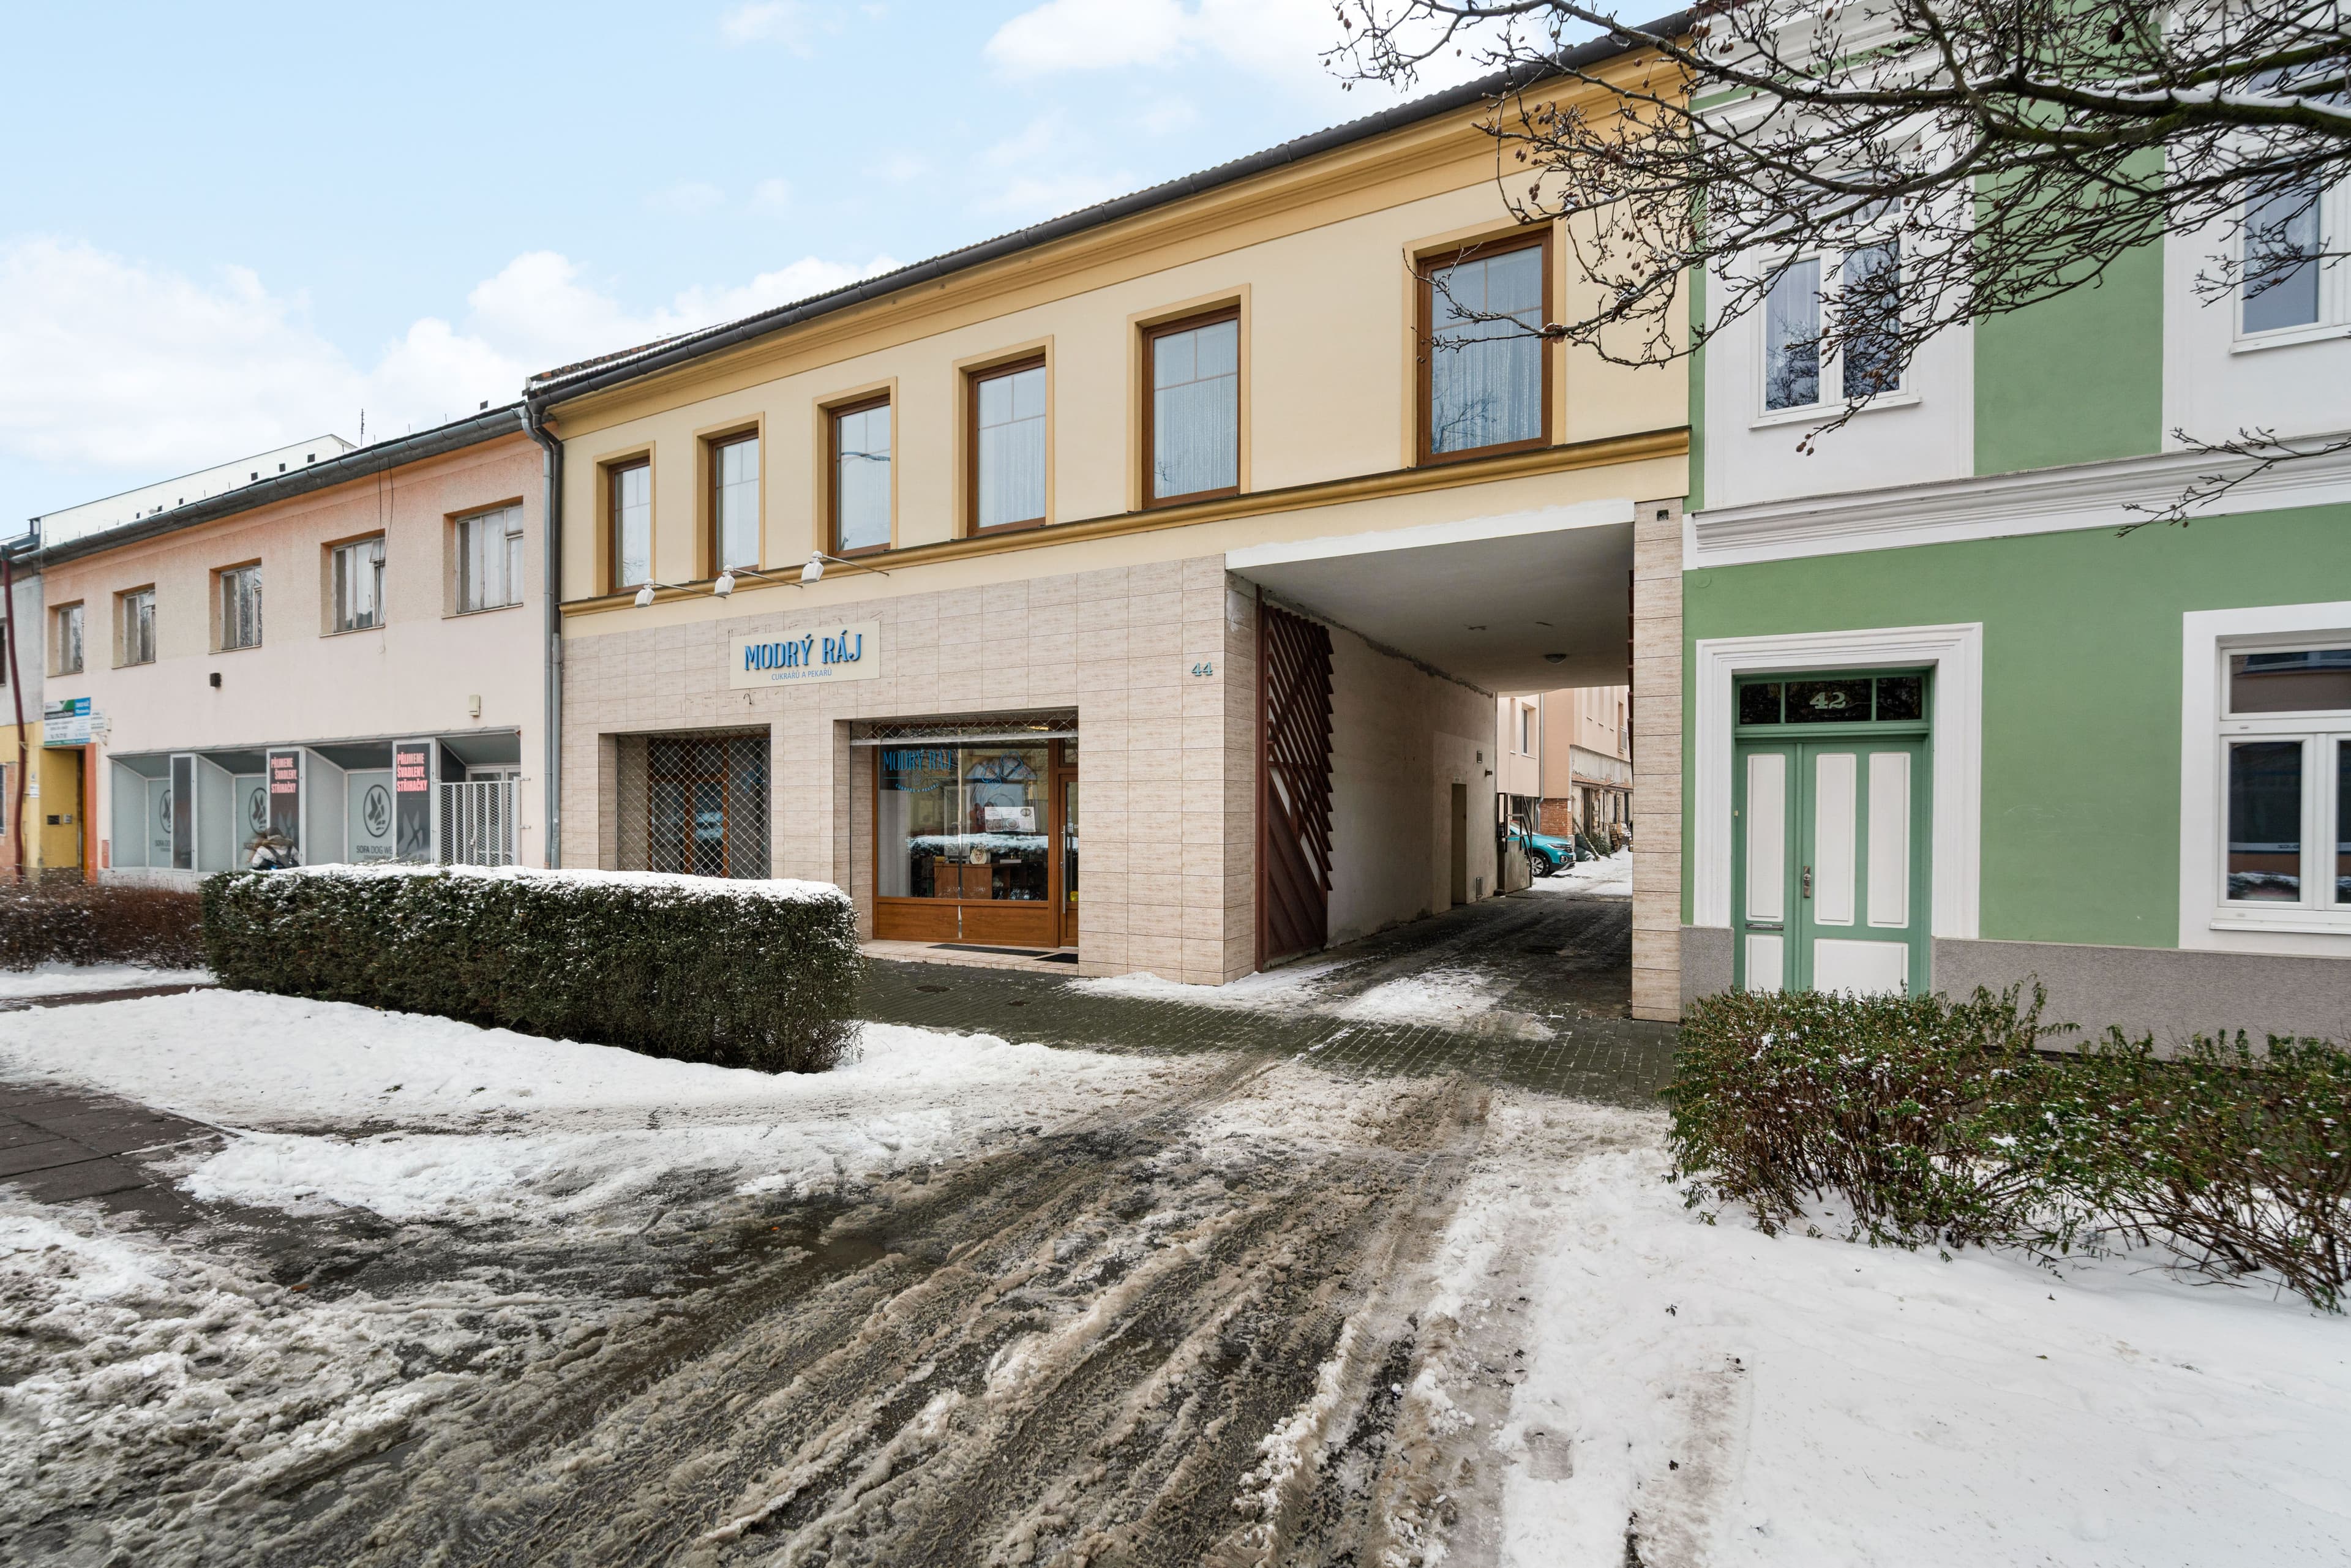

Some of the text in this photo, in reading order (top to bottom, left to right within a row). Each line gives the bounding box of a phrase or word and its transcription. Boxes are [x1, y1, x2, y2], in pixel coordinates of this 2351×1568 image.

[744, 629, 862, 670] MODRÝ RÁJ
[771, 670, 800, 681] CUKRÁŘŮ
[808, 667, 832, 677] PEKAŘŮ
[1191, 661, 1213, 677] 44
[1810, 692, 1846, 709] 42
[397, 752, 424, 765] PŘIJMEME
[883, 747, 924, 770] MODRÝ
[397, 778, 427, 792] STŘIHAČKY
[356, 845, 370, 853] SOFA
[371, 846, 383, 854] DOG
